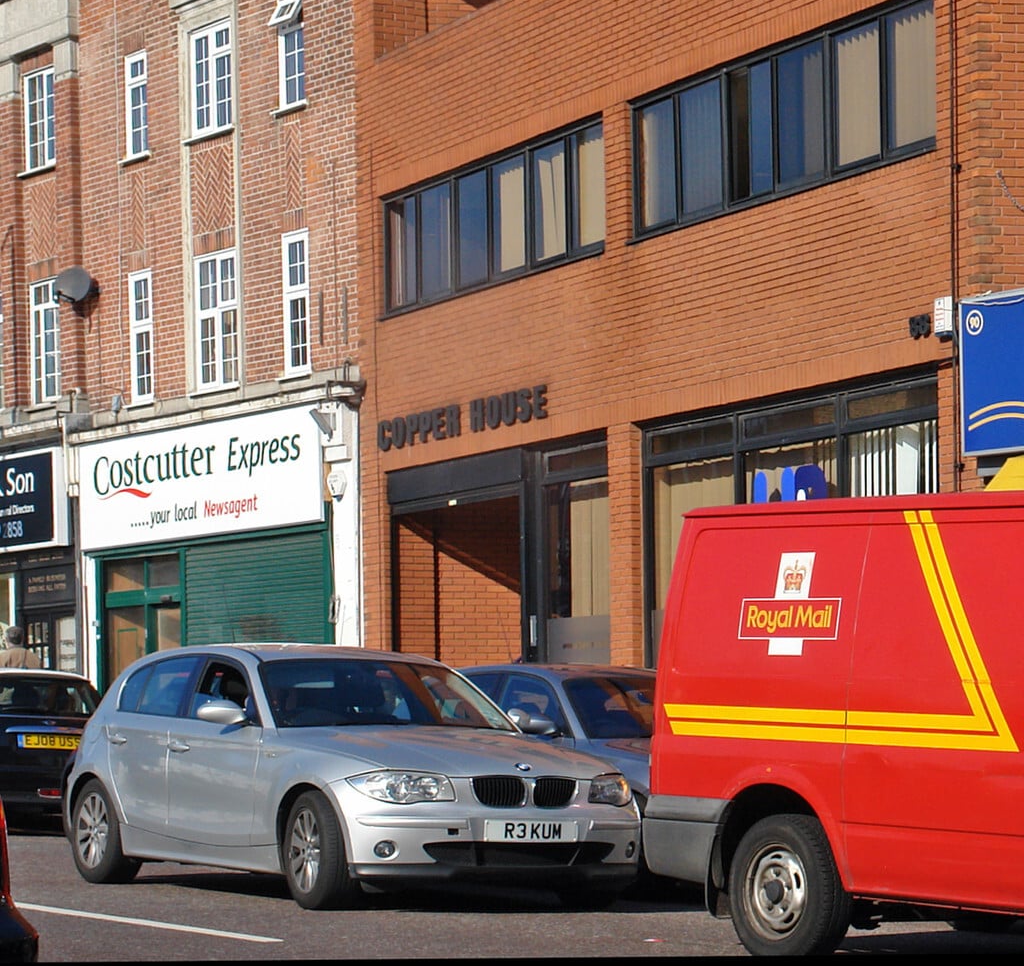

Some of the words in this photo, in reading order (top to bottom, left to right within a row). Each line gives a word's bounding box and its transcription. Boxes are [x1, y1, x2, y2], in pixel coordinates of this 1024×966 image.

[377, 404, 462, 452] COPPER
[469, 384, 549, 432] HOUSE
[93, 442, 216, 496] Costcutter
[227, 434, 301, 478] Express
[6, 467, 35, 496] Son
[174, 500, 198, 522] local
[203, 493, 258, 519] Newsagent
[746, 605, 794, 634] Royal
[794, 605, 833, 628] Mail
[504, 822, 527, 839] R3
[530, 822, 562, 840] KUM
